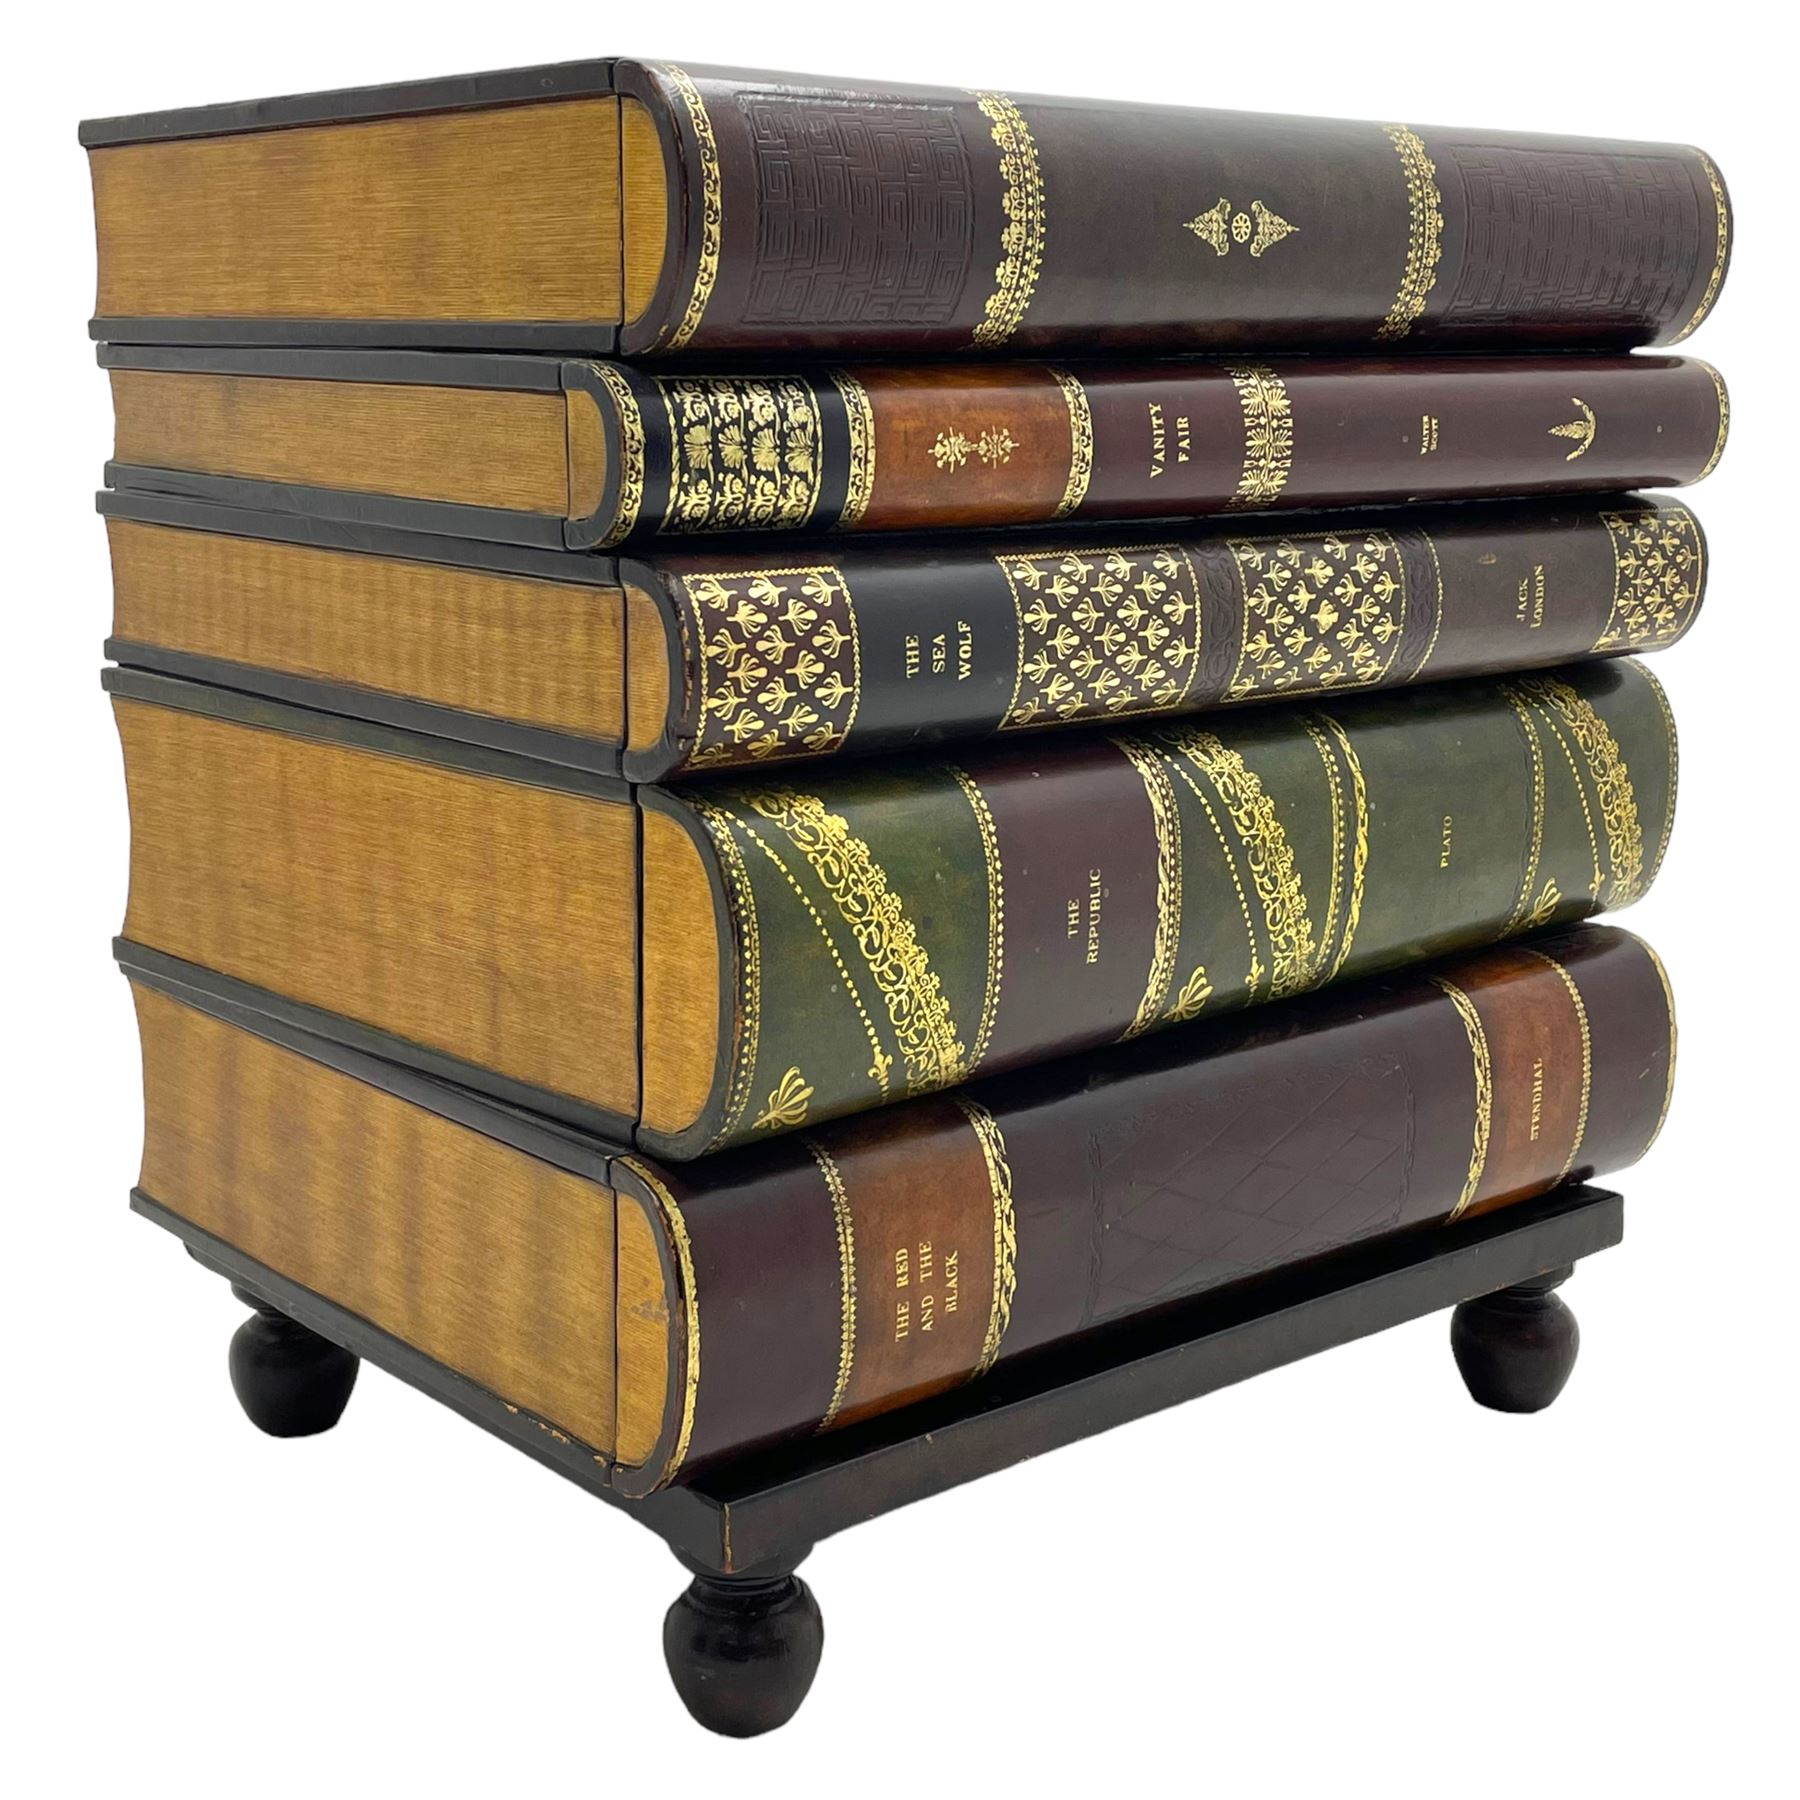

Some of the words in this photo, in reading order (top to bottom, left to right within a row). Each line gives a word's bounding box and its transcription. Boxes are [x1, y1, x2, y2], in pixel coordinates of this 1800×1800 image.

[1148, 402, 1165, 479] VANITY
[1176, 416, 1191, 463] FAIR
[1516, 577, 1529, 622] JACK
[1530, 564, 1545, 628] LONDON
[905, 634, 920, 679] THE
[932, 633, 946, 674] SEA
[957, 620, 973, 681] WOLF
[1440, 815, 1453, 868] PLATO
[1067, 898, 1080, 940] THE
[1086, 868, 1102, 964] REPUBLIC
[1530, 1057, 1543, 1141] STENDHAL
[895, 1247, 910, 1289] RED
[919, 1240, 933, 1284] THE
[945, 1249, 959, 1314] BLACK
[895, 1300, 910, 1343] THE
[921, 1294, 935, 1332] AND
